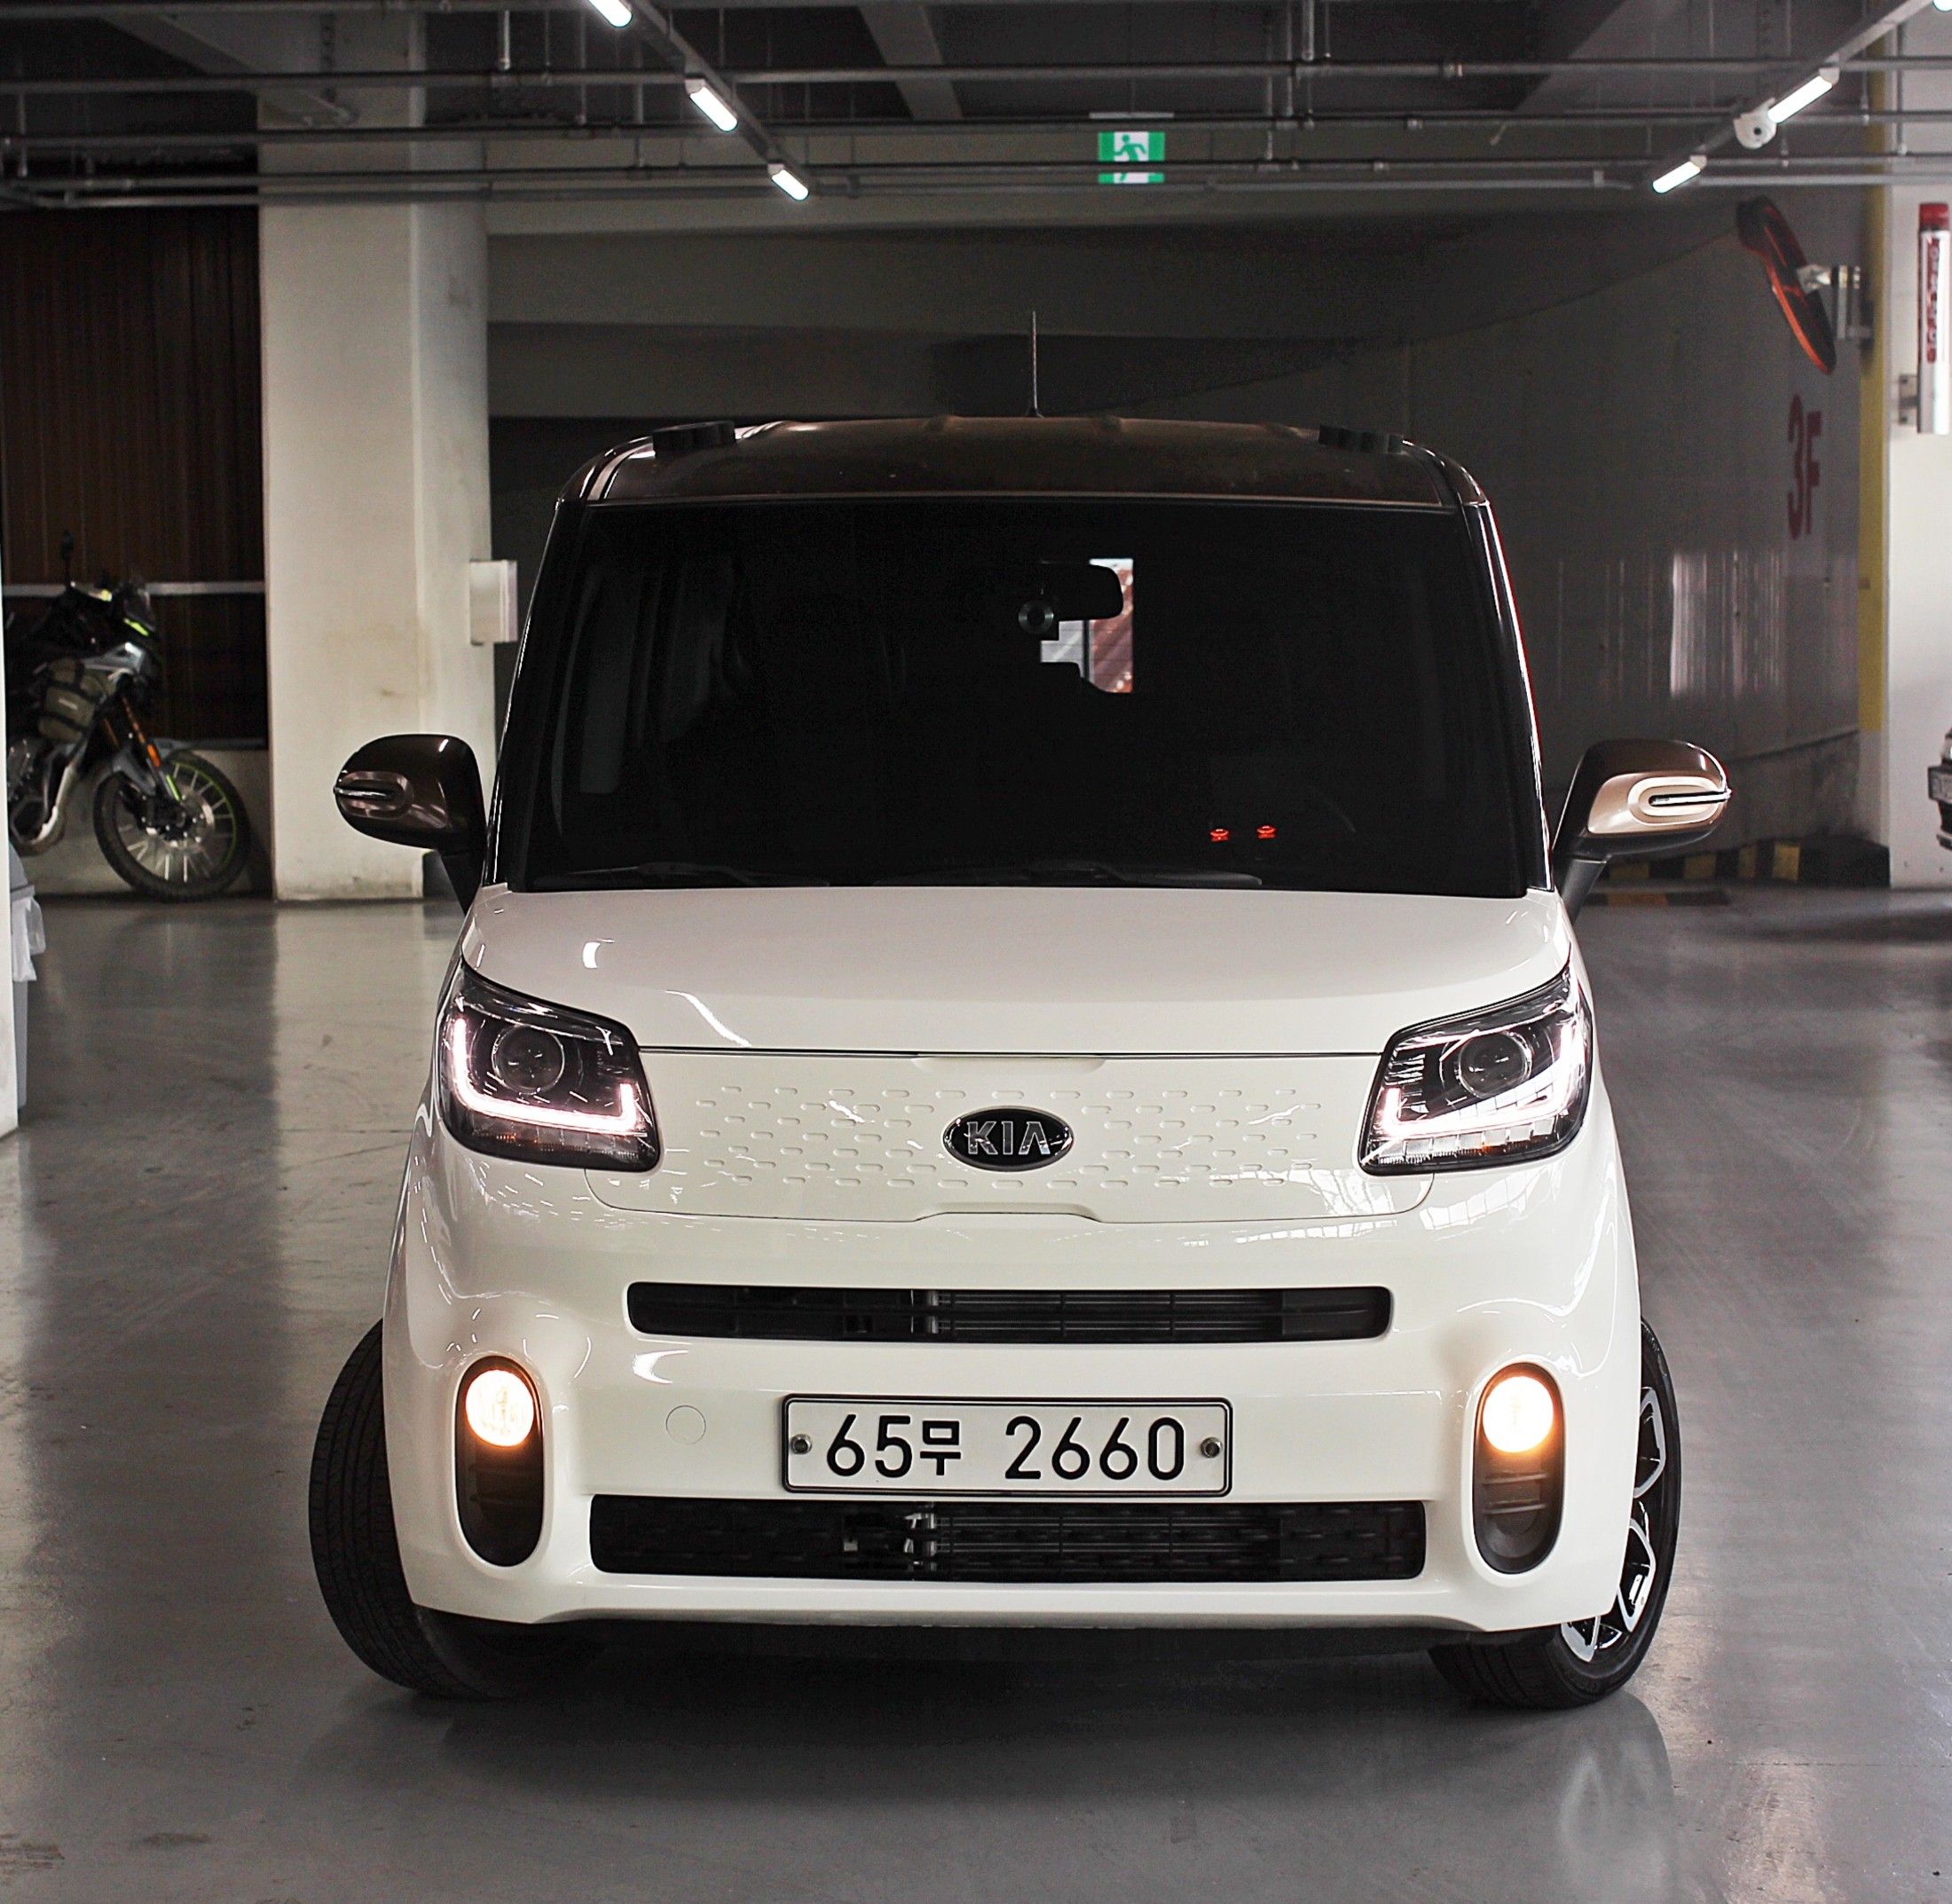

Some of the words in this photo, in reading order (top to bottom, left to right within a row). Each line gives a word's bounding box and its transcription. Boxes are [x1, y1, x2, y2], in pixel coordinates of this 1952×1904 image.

[1787, 393, 1822, 540] 3F
[966, 1121, 1051, 1155] KIA
[826, 1413, 962, 1478] 65무
[1004, 1415, 1185, 1481] 2660
